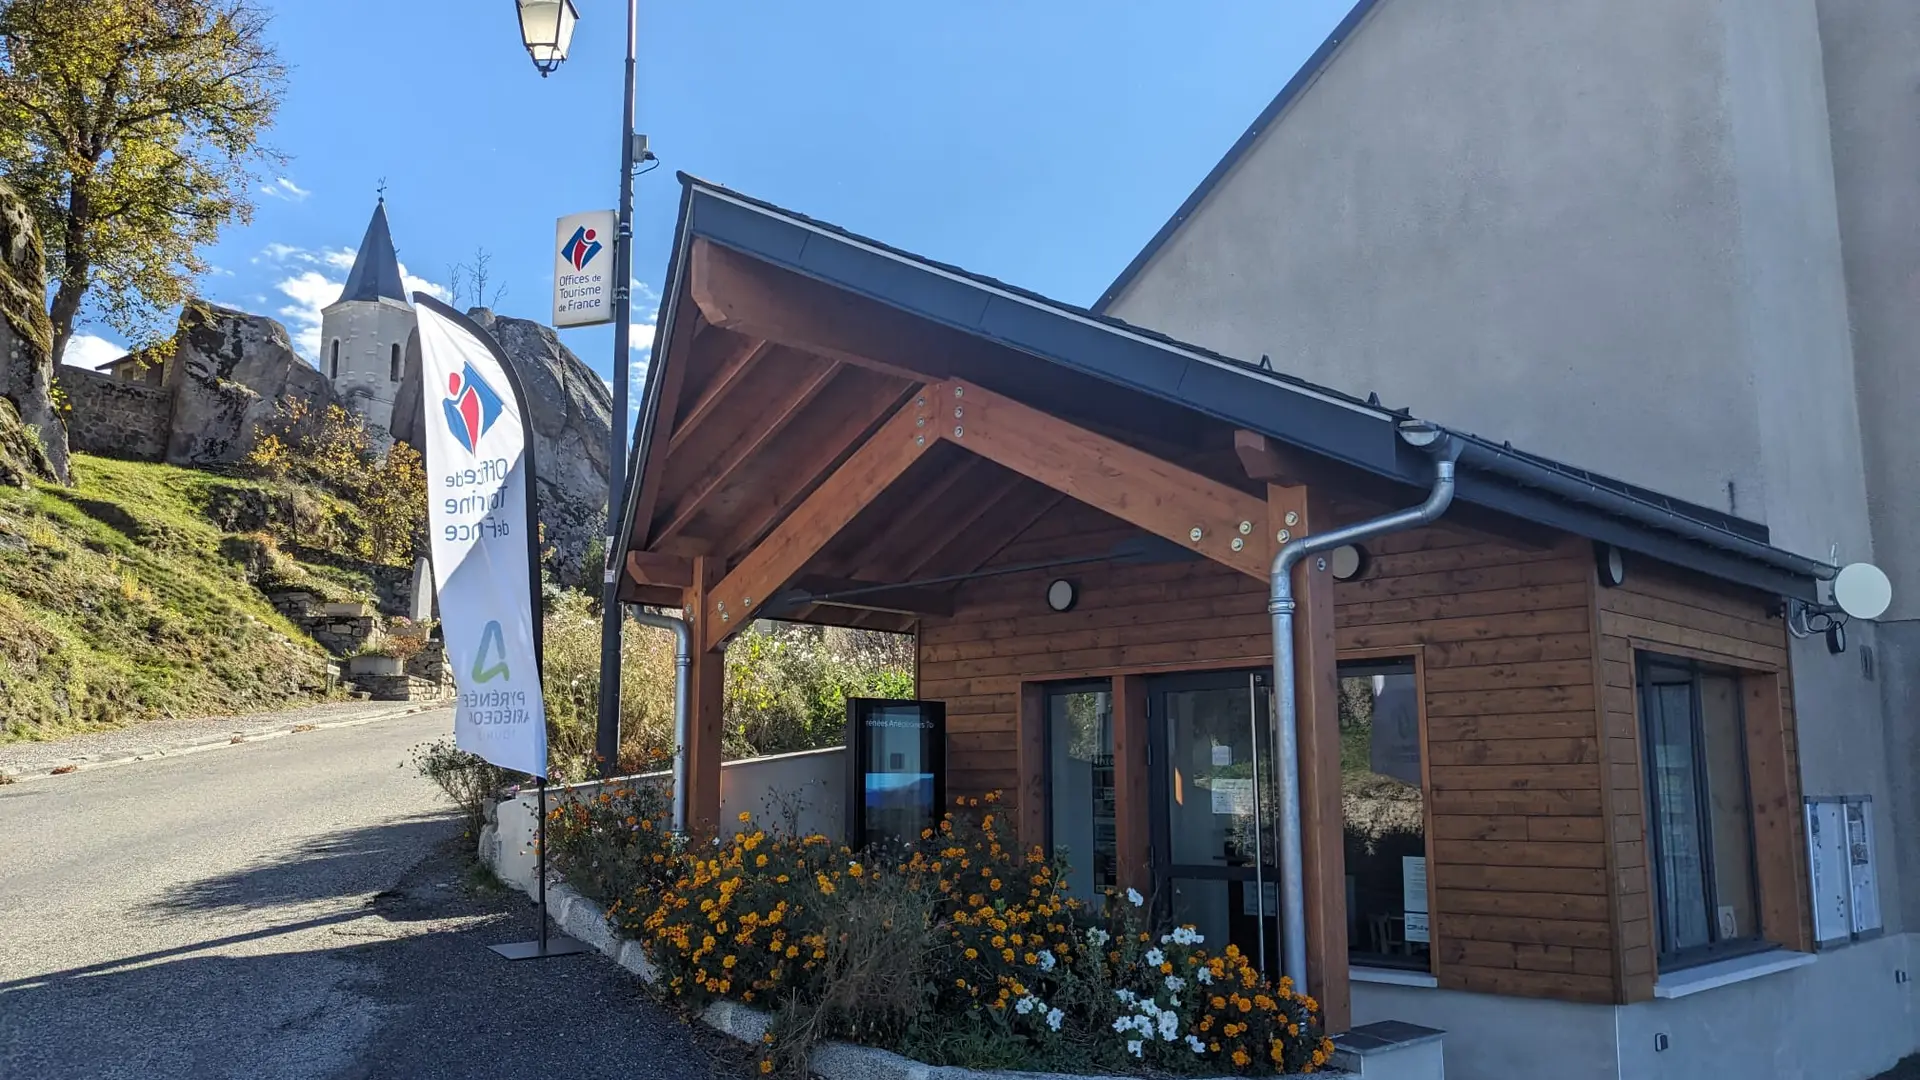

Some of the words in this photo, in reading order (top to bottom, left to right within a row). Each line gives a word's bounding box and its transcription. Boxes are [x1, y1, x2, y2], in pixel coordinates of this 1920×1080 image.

[560, 274, 589, 286] Offices
[592, 274, 601, 282] de
[559, 286, 601, 298] Tourisme
[559, 304, 566, 312] de
[568, 299, 601, 311] France
